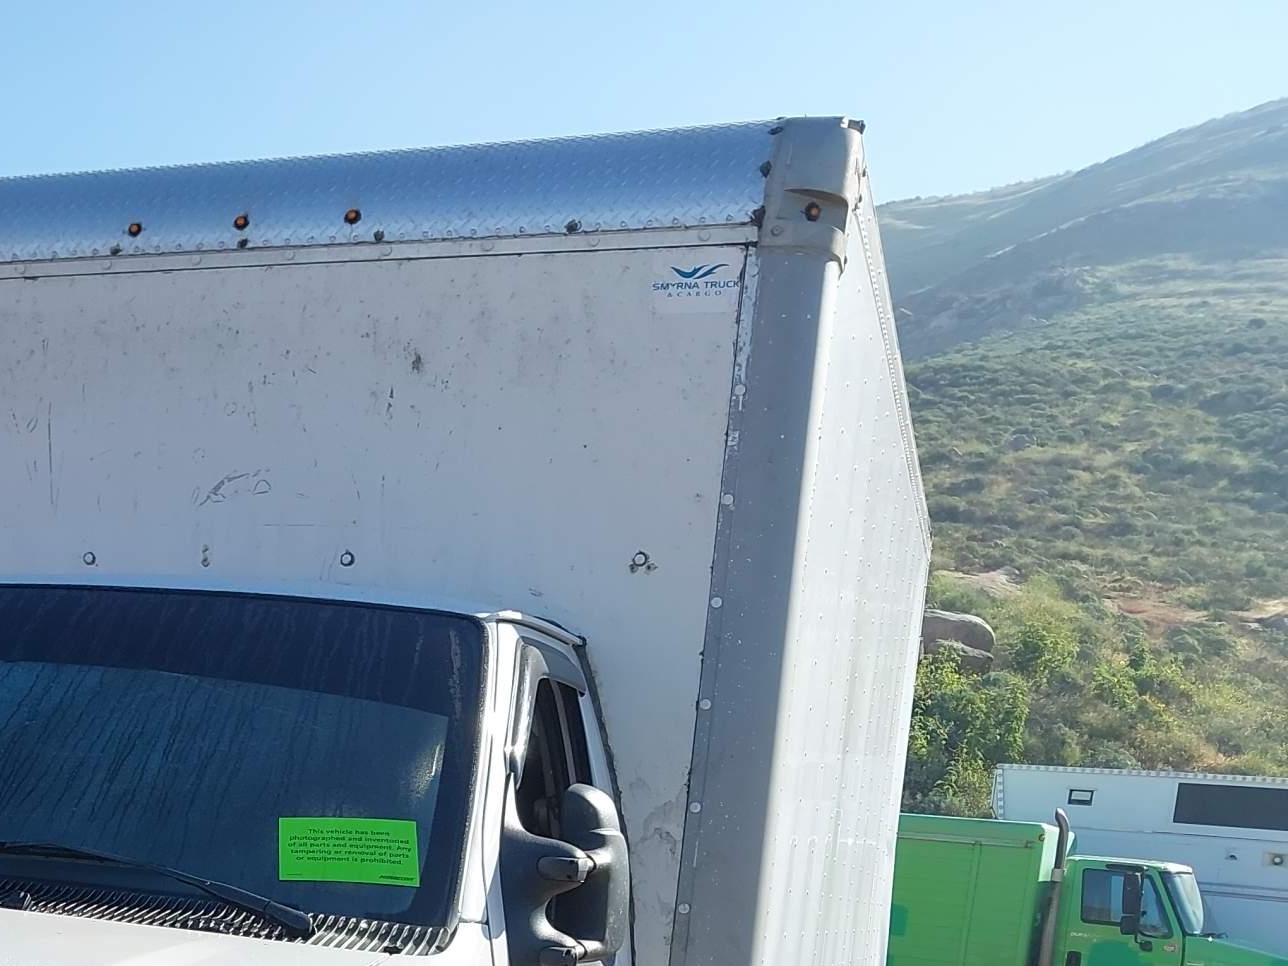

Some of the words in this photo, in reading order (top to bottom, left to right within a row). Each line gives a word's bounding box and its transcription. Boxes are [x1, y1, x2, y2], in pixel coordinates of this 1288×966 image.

[652, 281, 700, 291] SMYRNA
[704, 280, 740, 289] TRUCK
[364, 837, 409, 845] inventoried
